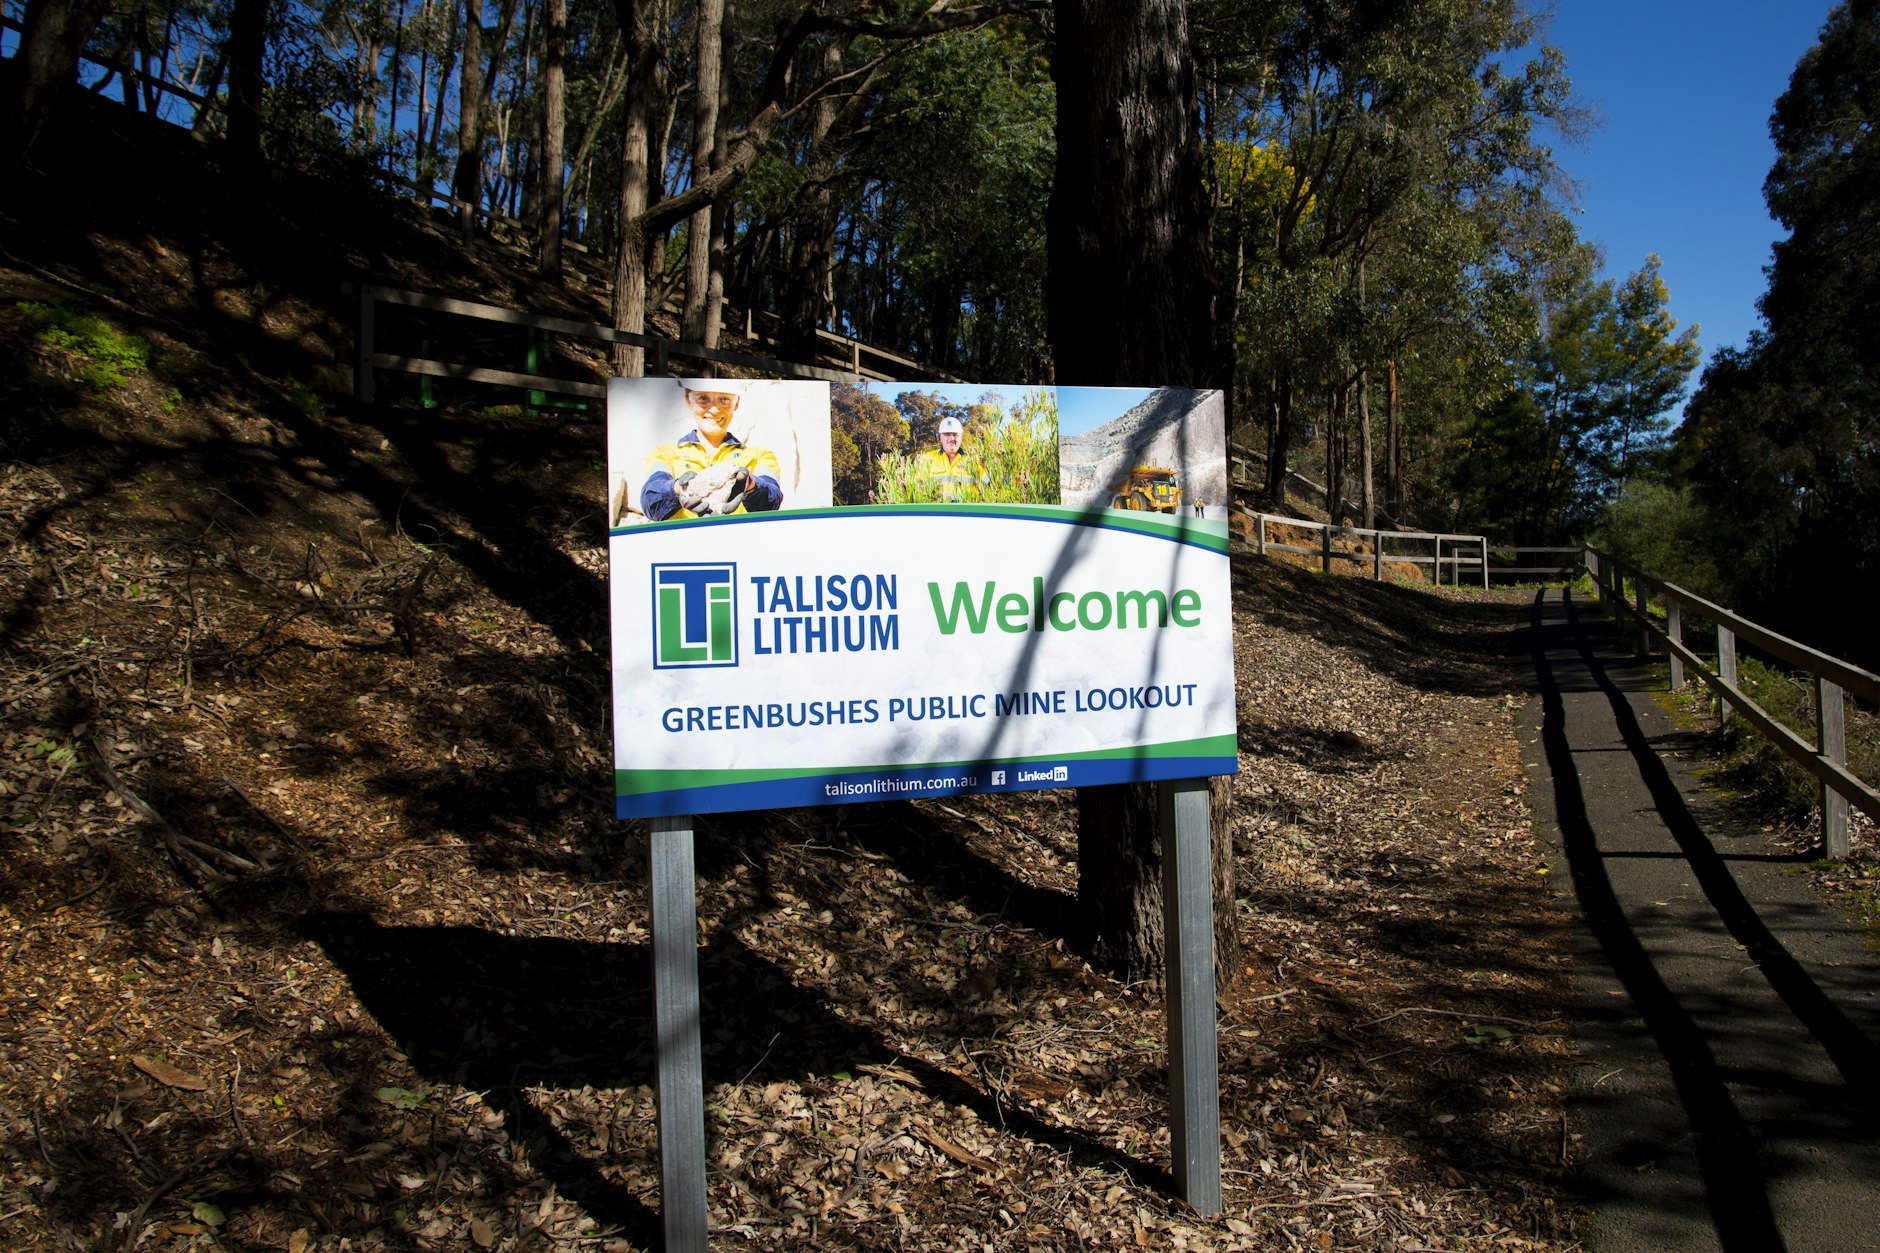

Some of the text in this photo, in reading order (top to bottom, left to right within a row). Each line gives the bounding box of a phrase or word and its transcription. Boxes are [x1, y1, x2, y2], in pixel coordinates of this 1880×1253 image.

[750, 574, 898, 613] TALISON
[928, 576, 1202, 636] Welcome
[753, 614, 900, 655] LITHIUM
[661, 684, 1198, 733] GREENBUSHES PUBLIC MINE LOOKOUT
[824, 777, 978, 797] talisonlithium.com.au
